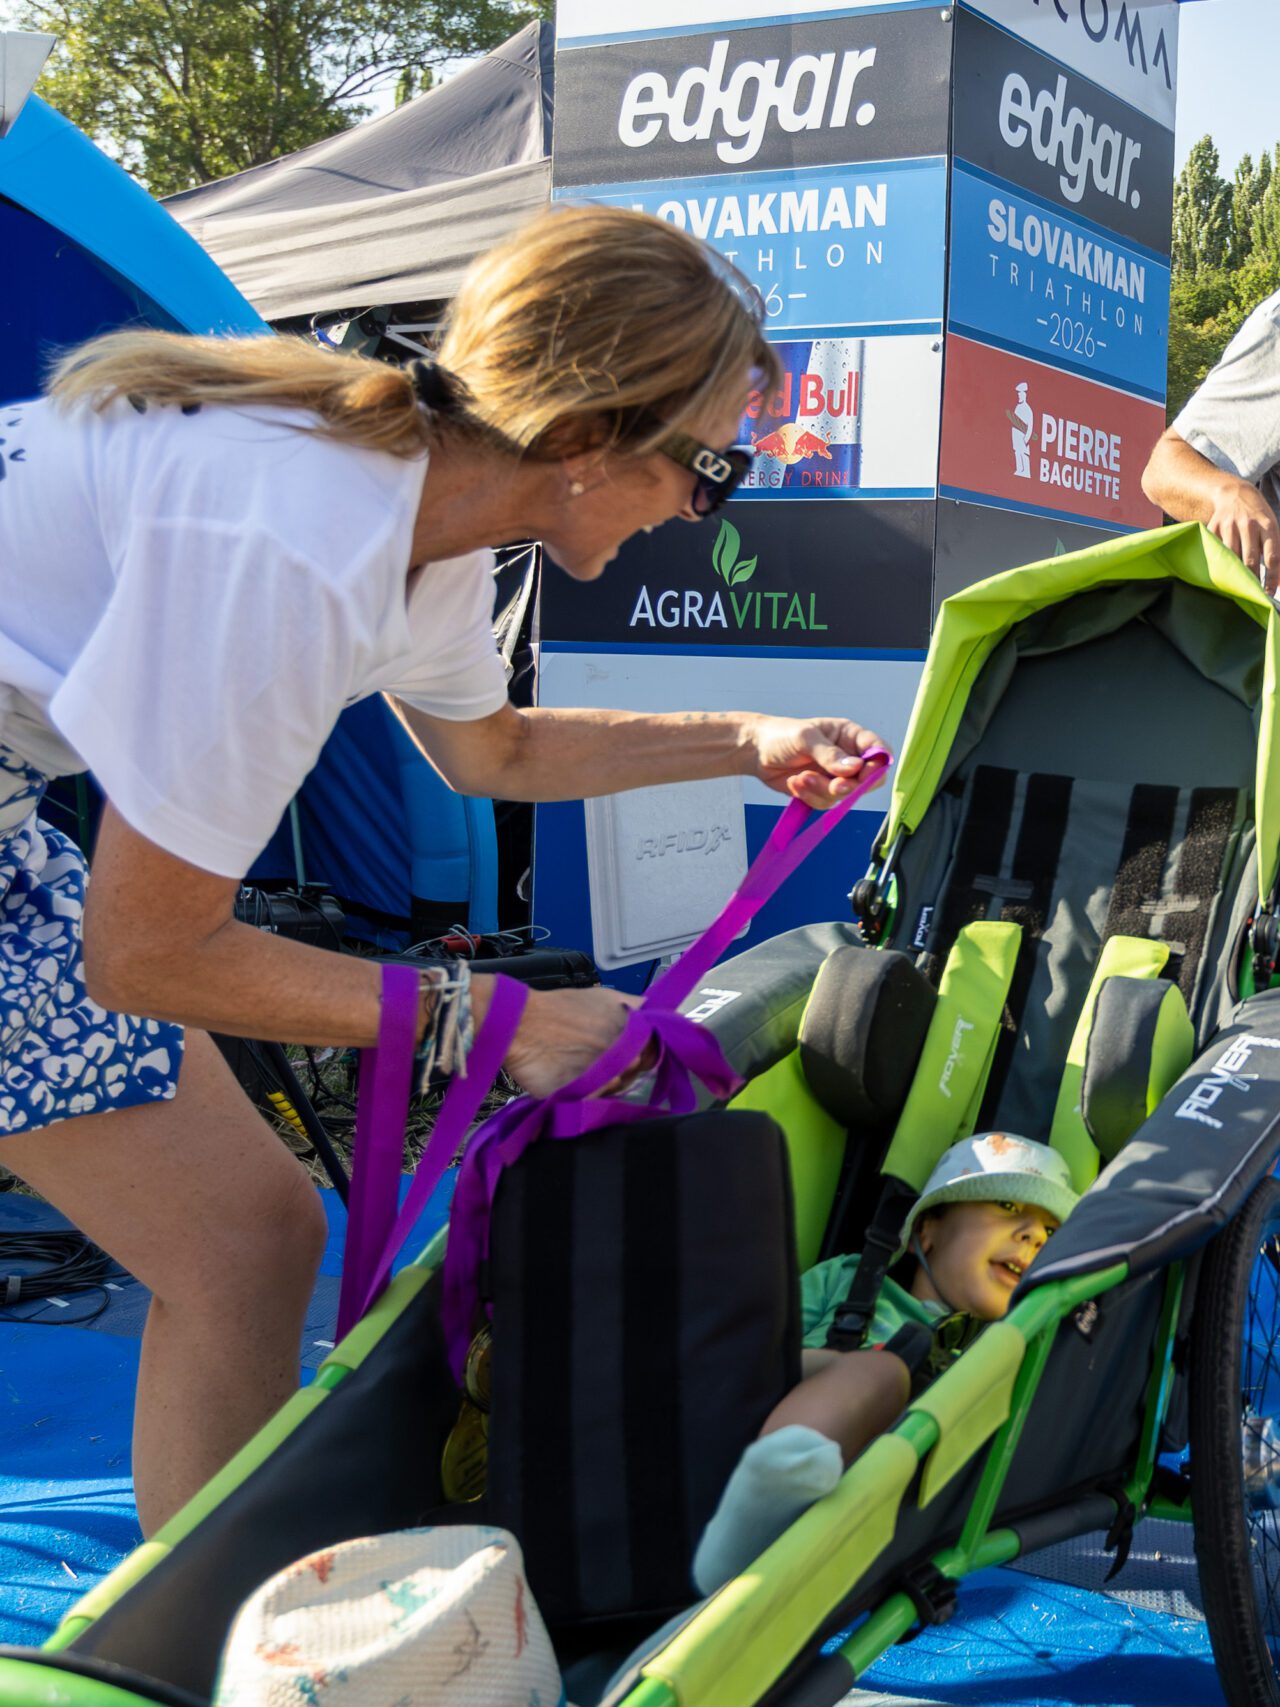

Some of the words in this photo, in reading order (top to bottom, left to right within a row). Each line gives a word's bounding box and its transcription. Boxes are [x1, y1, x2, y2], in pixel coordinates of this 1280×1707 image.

[617, 39, 878, 164] edgar.
[999, 73, 1141, 209] edgar.
[620, 184, 887, 239] OVAKMAN
[725, 241, 883, 272] THLON
[988, 199, 1145, 303] SLOVAKMAN
[989, 254, 1142, 335] TRIATHLON
[800, 371, 859, 417] Bull
[1041, 413, 1121, 472] PIERRE
[740, 470, 793, 487] ERGY
[1039, 457, 1120, 500] BAGUETTE
[630, 585, 828, 631] AGRAVITAL
